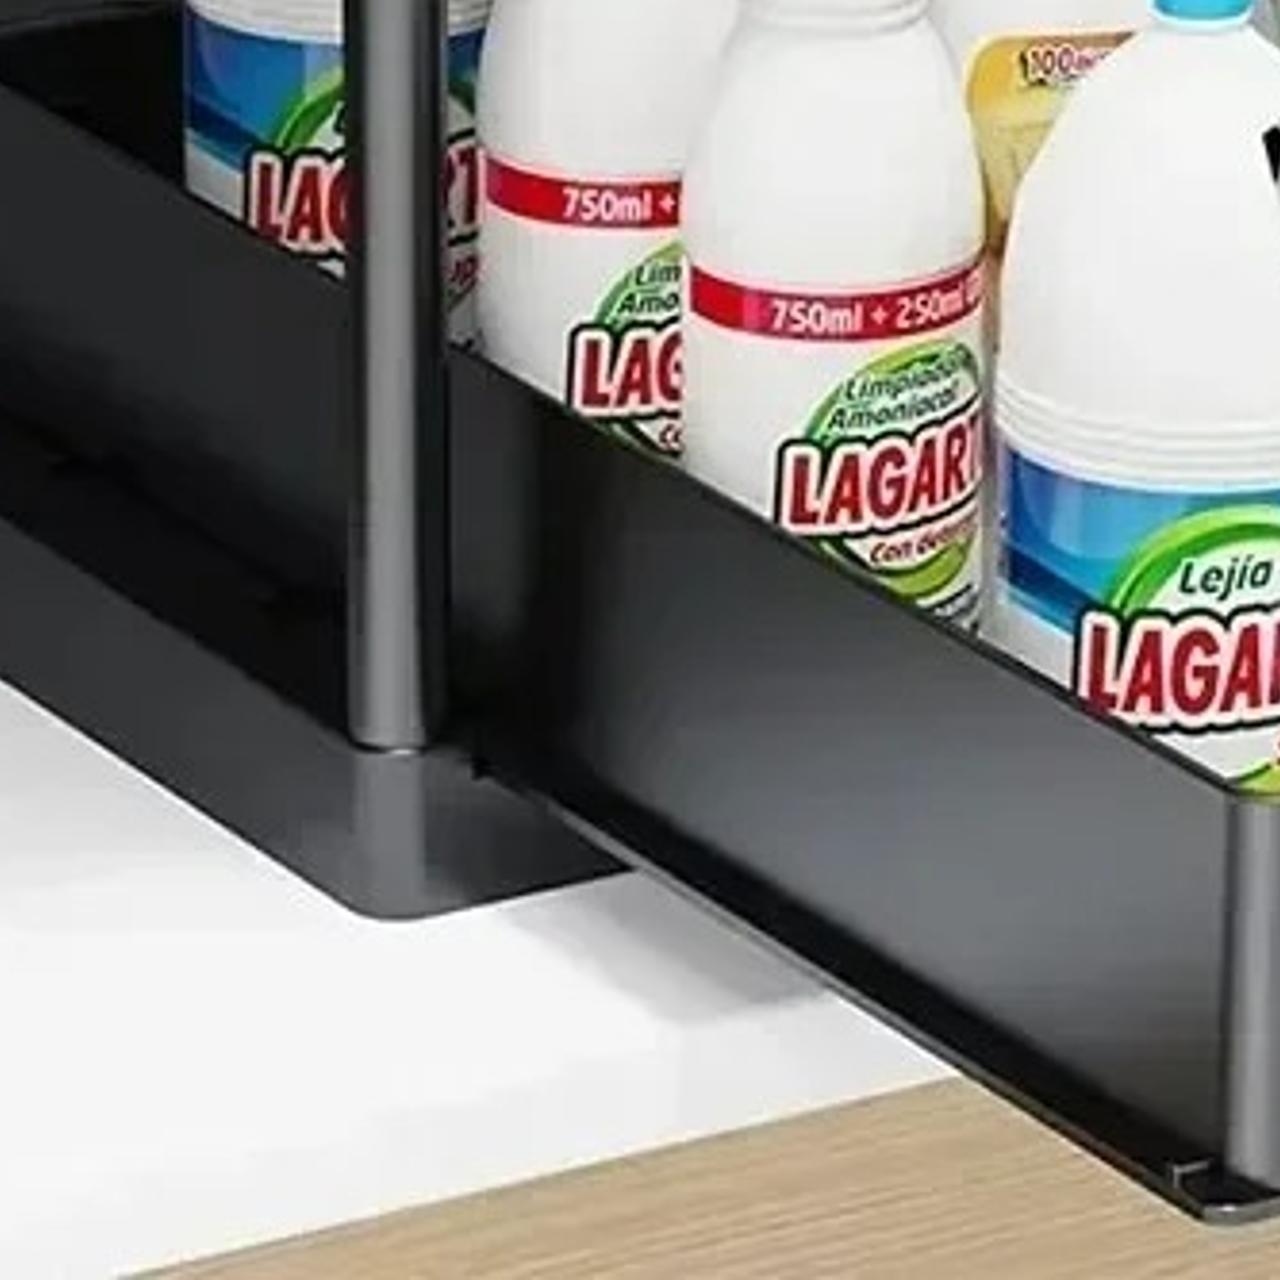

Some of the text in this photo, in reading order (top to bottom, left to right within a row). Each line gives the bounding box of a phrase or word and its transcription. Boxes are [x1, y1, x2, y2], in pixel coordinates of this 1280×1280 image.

[562, 189, 652, 221] 750ml
[772, 298, 865, 334] 750ml
[1178, 551, 1274, 602] Lejía
